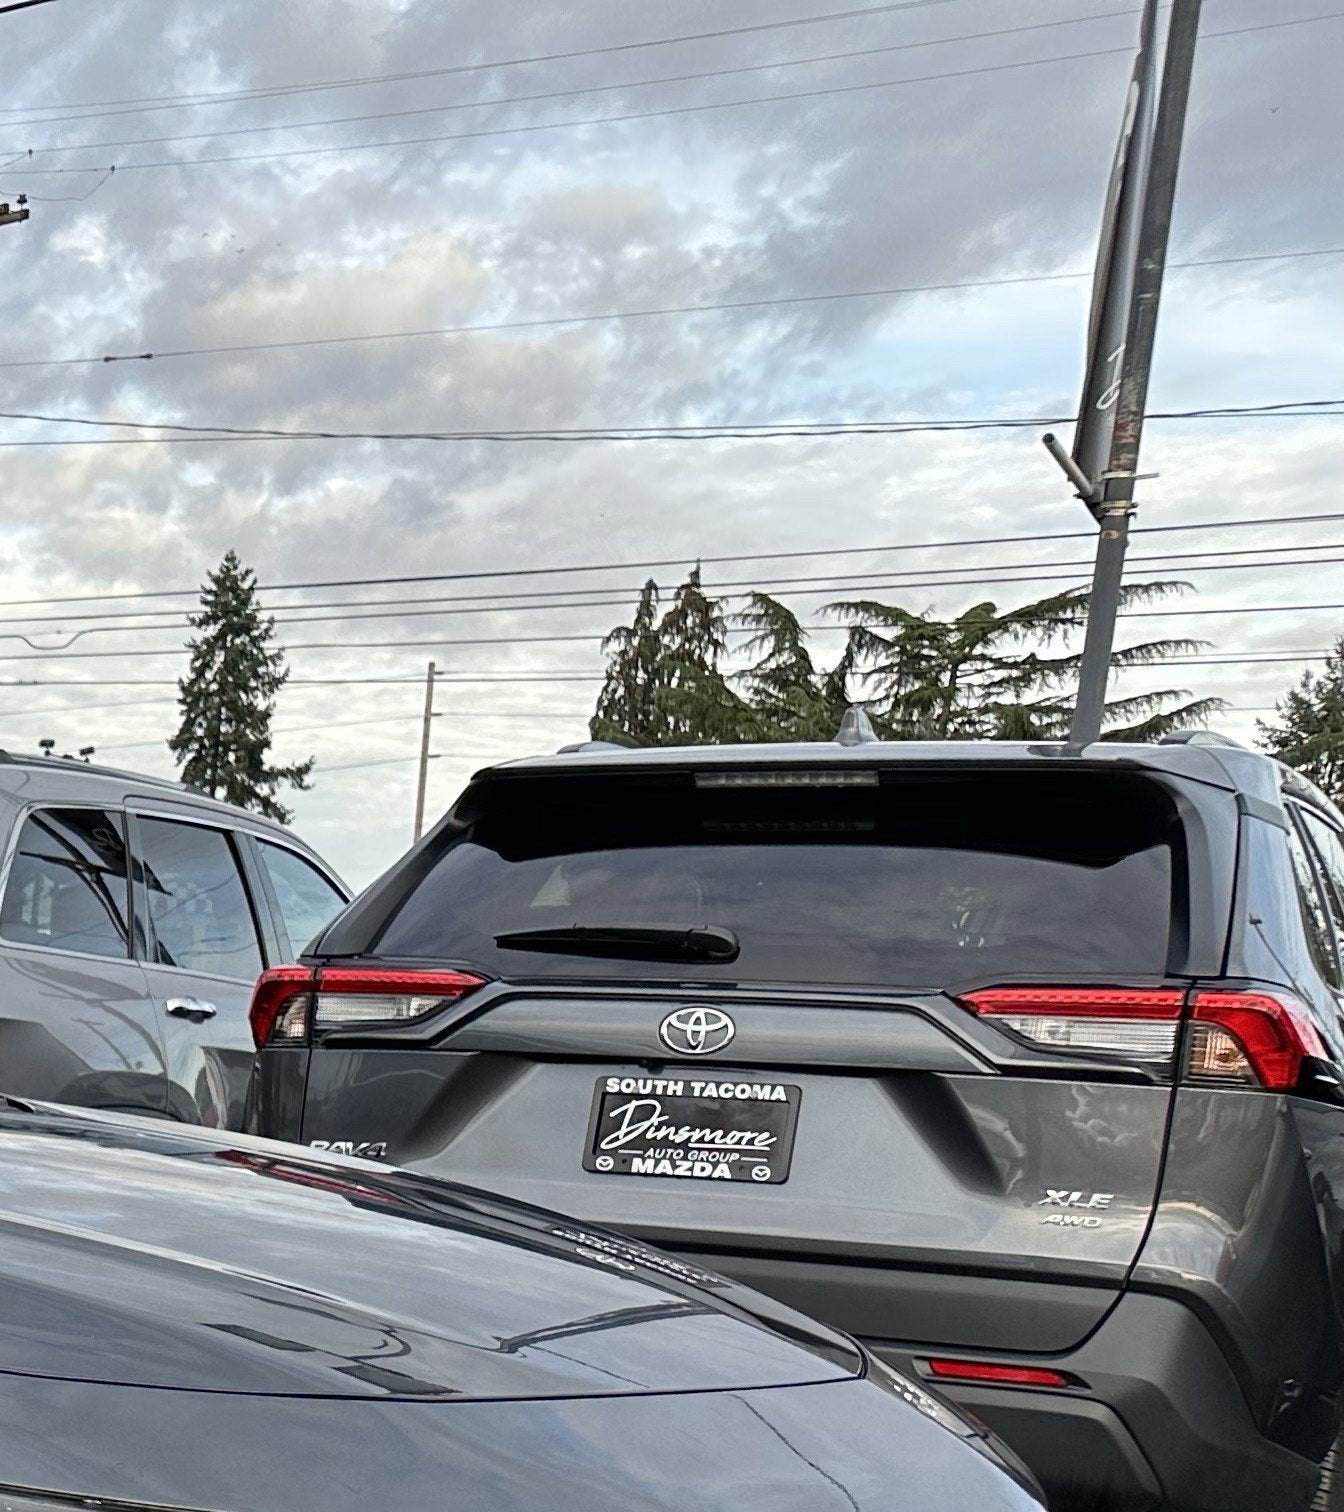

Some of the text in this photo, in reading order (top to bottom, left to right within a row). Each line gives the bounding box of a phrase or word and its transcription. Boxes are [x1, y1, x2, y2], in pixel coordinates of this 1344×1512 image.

[606, 1078, 787, 1101] SOUTH TACOMA
[600, 1099, 777, 1150] Dinsmore
[644, 1148, 740, 1163] AUTO GROUP
[631, 1158, 732, 1179] MAZDA
[1038, 1190, 1114, 1209] XLE
[1040, 1214, 1103, 1228] AWD
